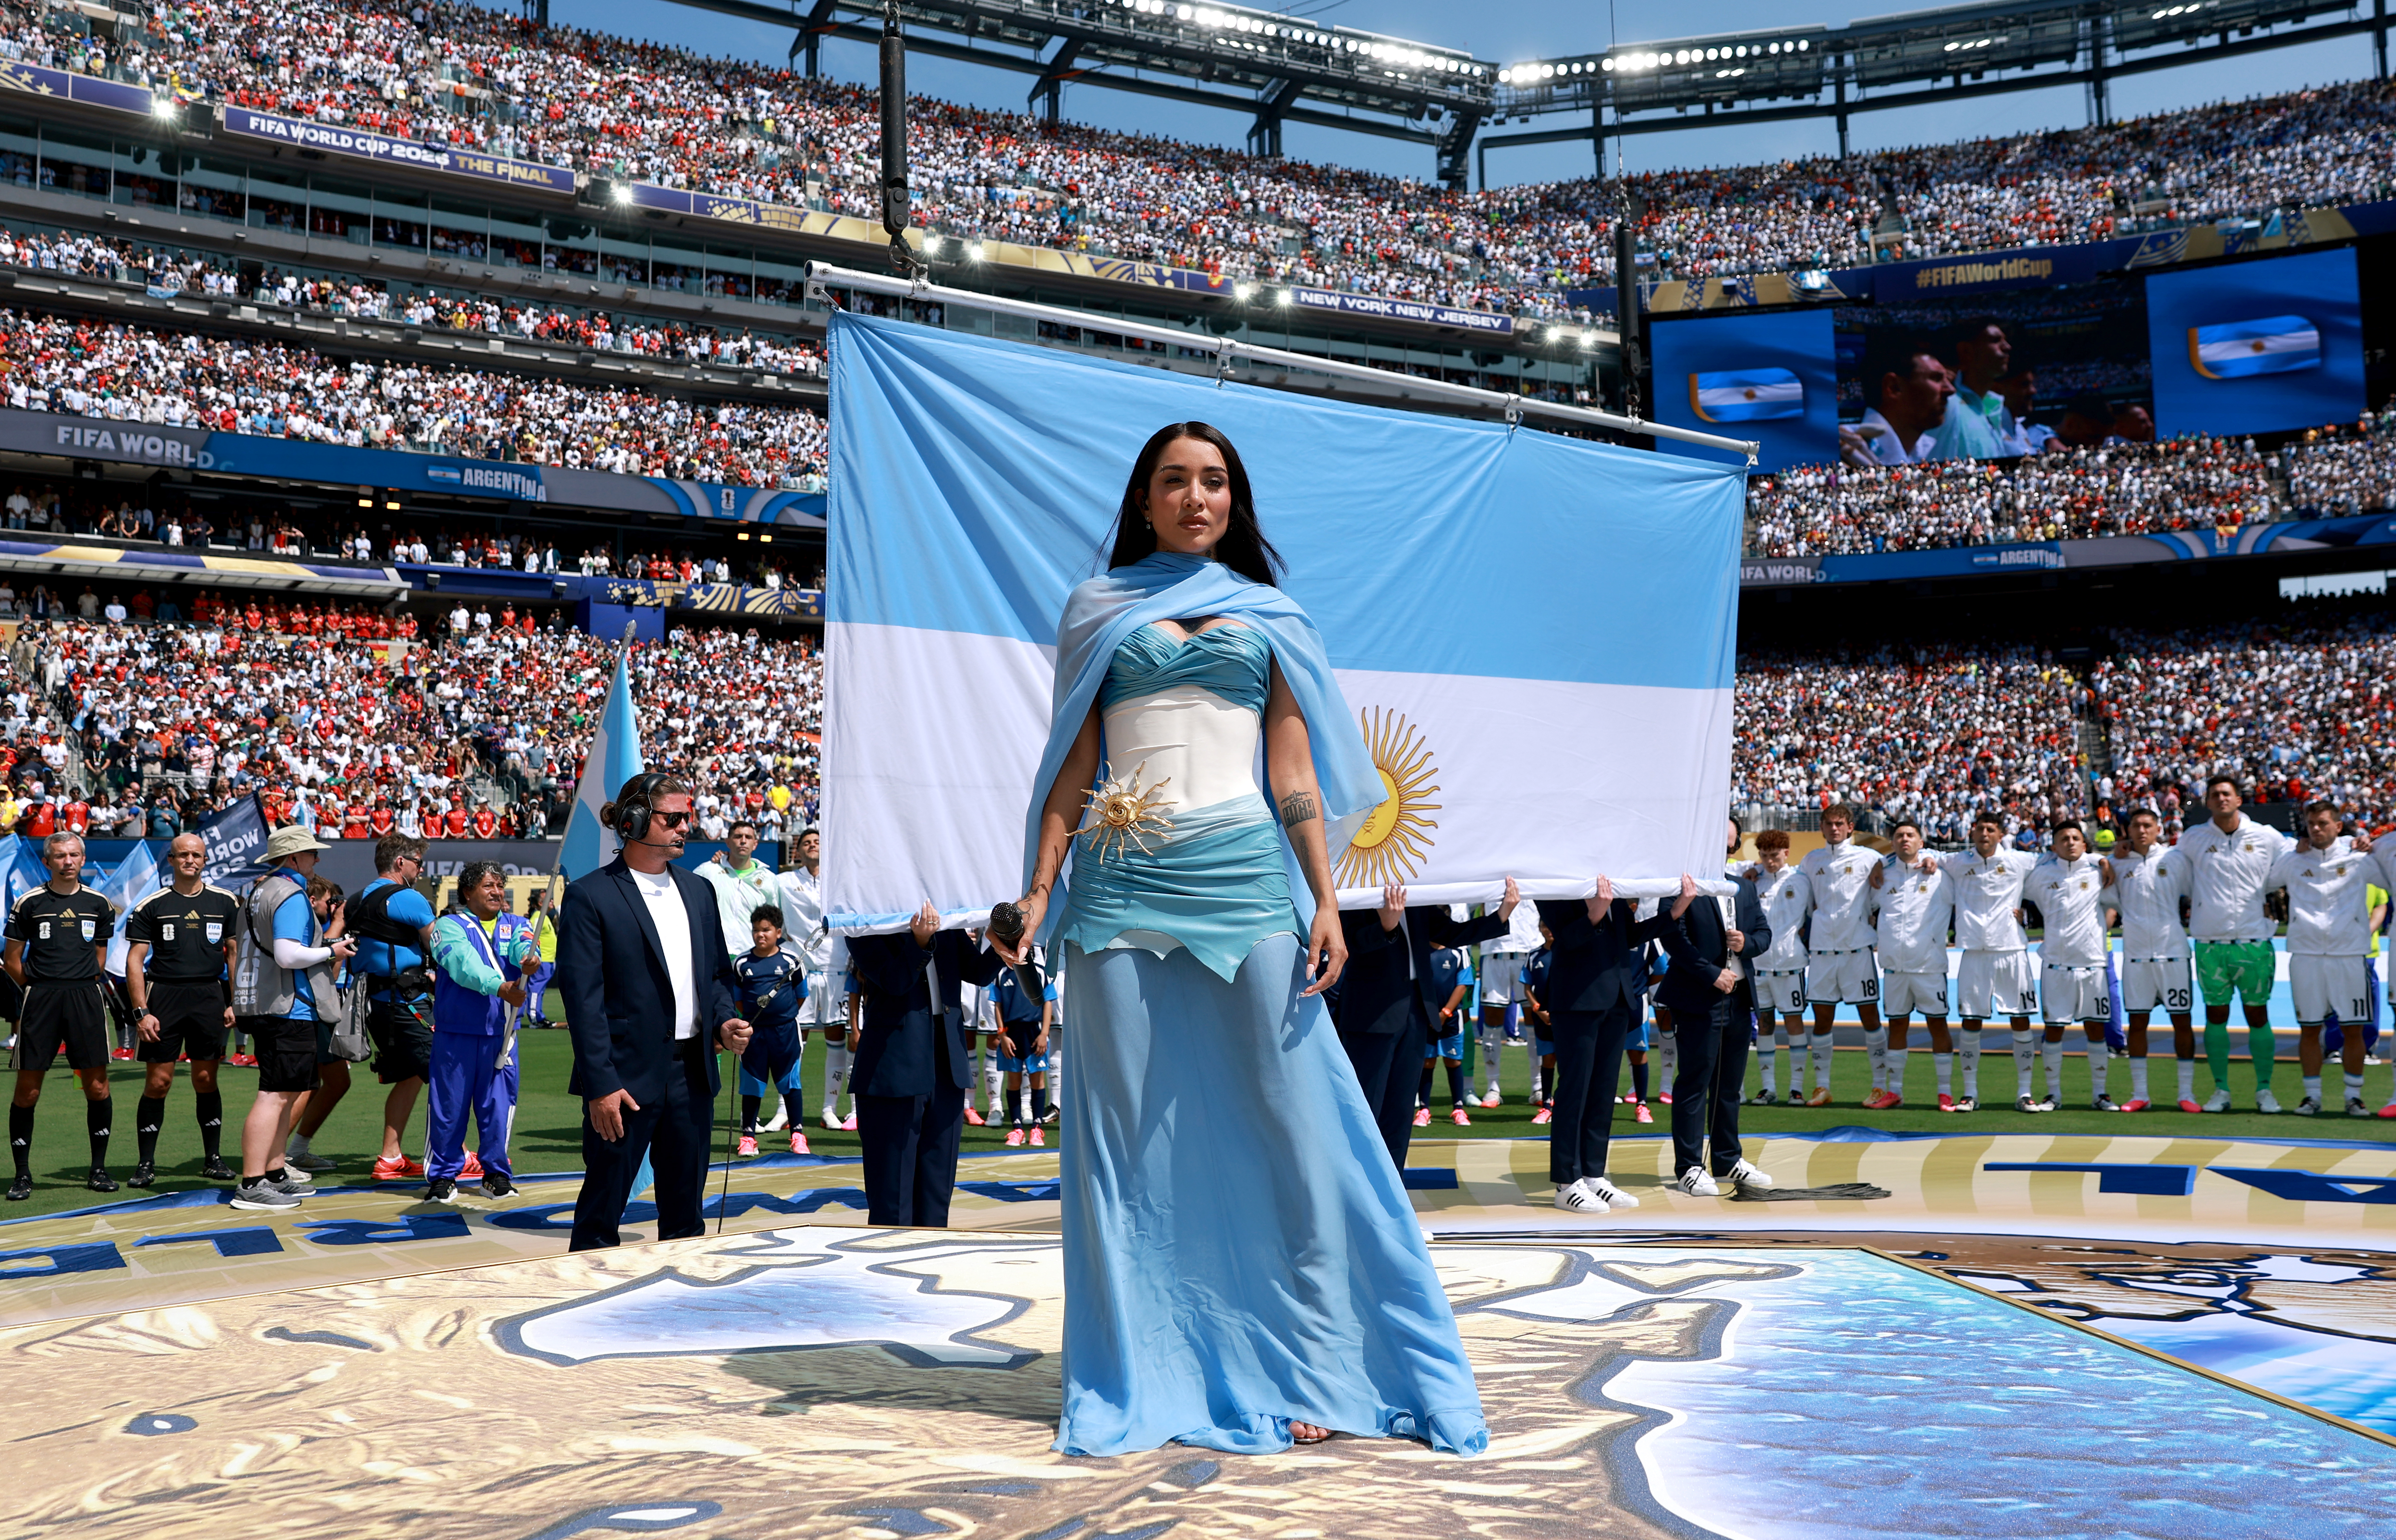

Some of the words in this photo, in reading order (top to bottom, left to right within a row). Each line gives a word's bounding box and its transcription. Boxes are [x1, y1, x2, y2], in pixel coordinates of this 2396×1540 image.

[249, 116, 288, 137] FIFA
[289, 123, 353, 148] WORLD
[355, 137, 390, 154] CUP
[391, 143, 450, 166] 2026
[455, 154, 495, 174] THE
[497, 163, 553, 184] FINAL
[1916, 257, 2054, 289] #FIFAWorldCup
[1300, 291, 1341, 306] NEW
[1344, 296, 1393, 314] YORK
[1395, 303, 1434, 319] NEW
[1437, 310, 1503, 329] JERSEY
[57, 425, 116, 451] FIFA
[119, 432, 215, 468] WORLD
[463, 467, 547, 502] ARGENTINA
[1999, 549, 2066, 569] ARGENTINA
[1740, 566, 1766, 579] IFA
[1766, 565, 1827, 583] WORLD
[1283, 799, 1317, 829] HIGH
[1861, 979, 1876, 997] 18
[2168, 988, 2188, 1007] 26
[234, 995, 257, 1005] 206
[1791, 990, 1801, 1007] 8
[1937, 990, 1947, 1009] 4
[2020, 990, 2037, 1009] 14
[2094, 997, 2109, 1015] 16
[2352, 998, 2365, 1017] 11
[838, 1000, 849, 1017] 13
